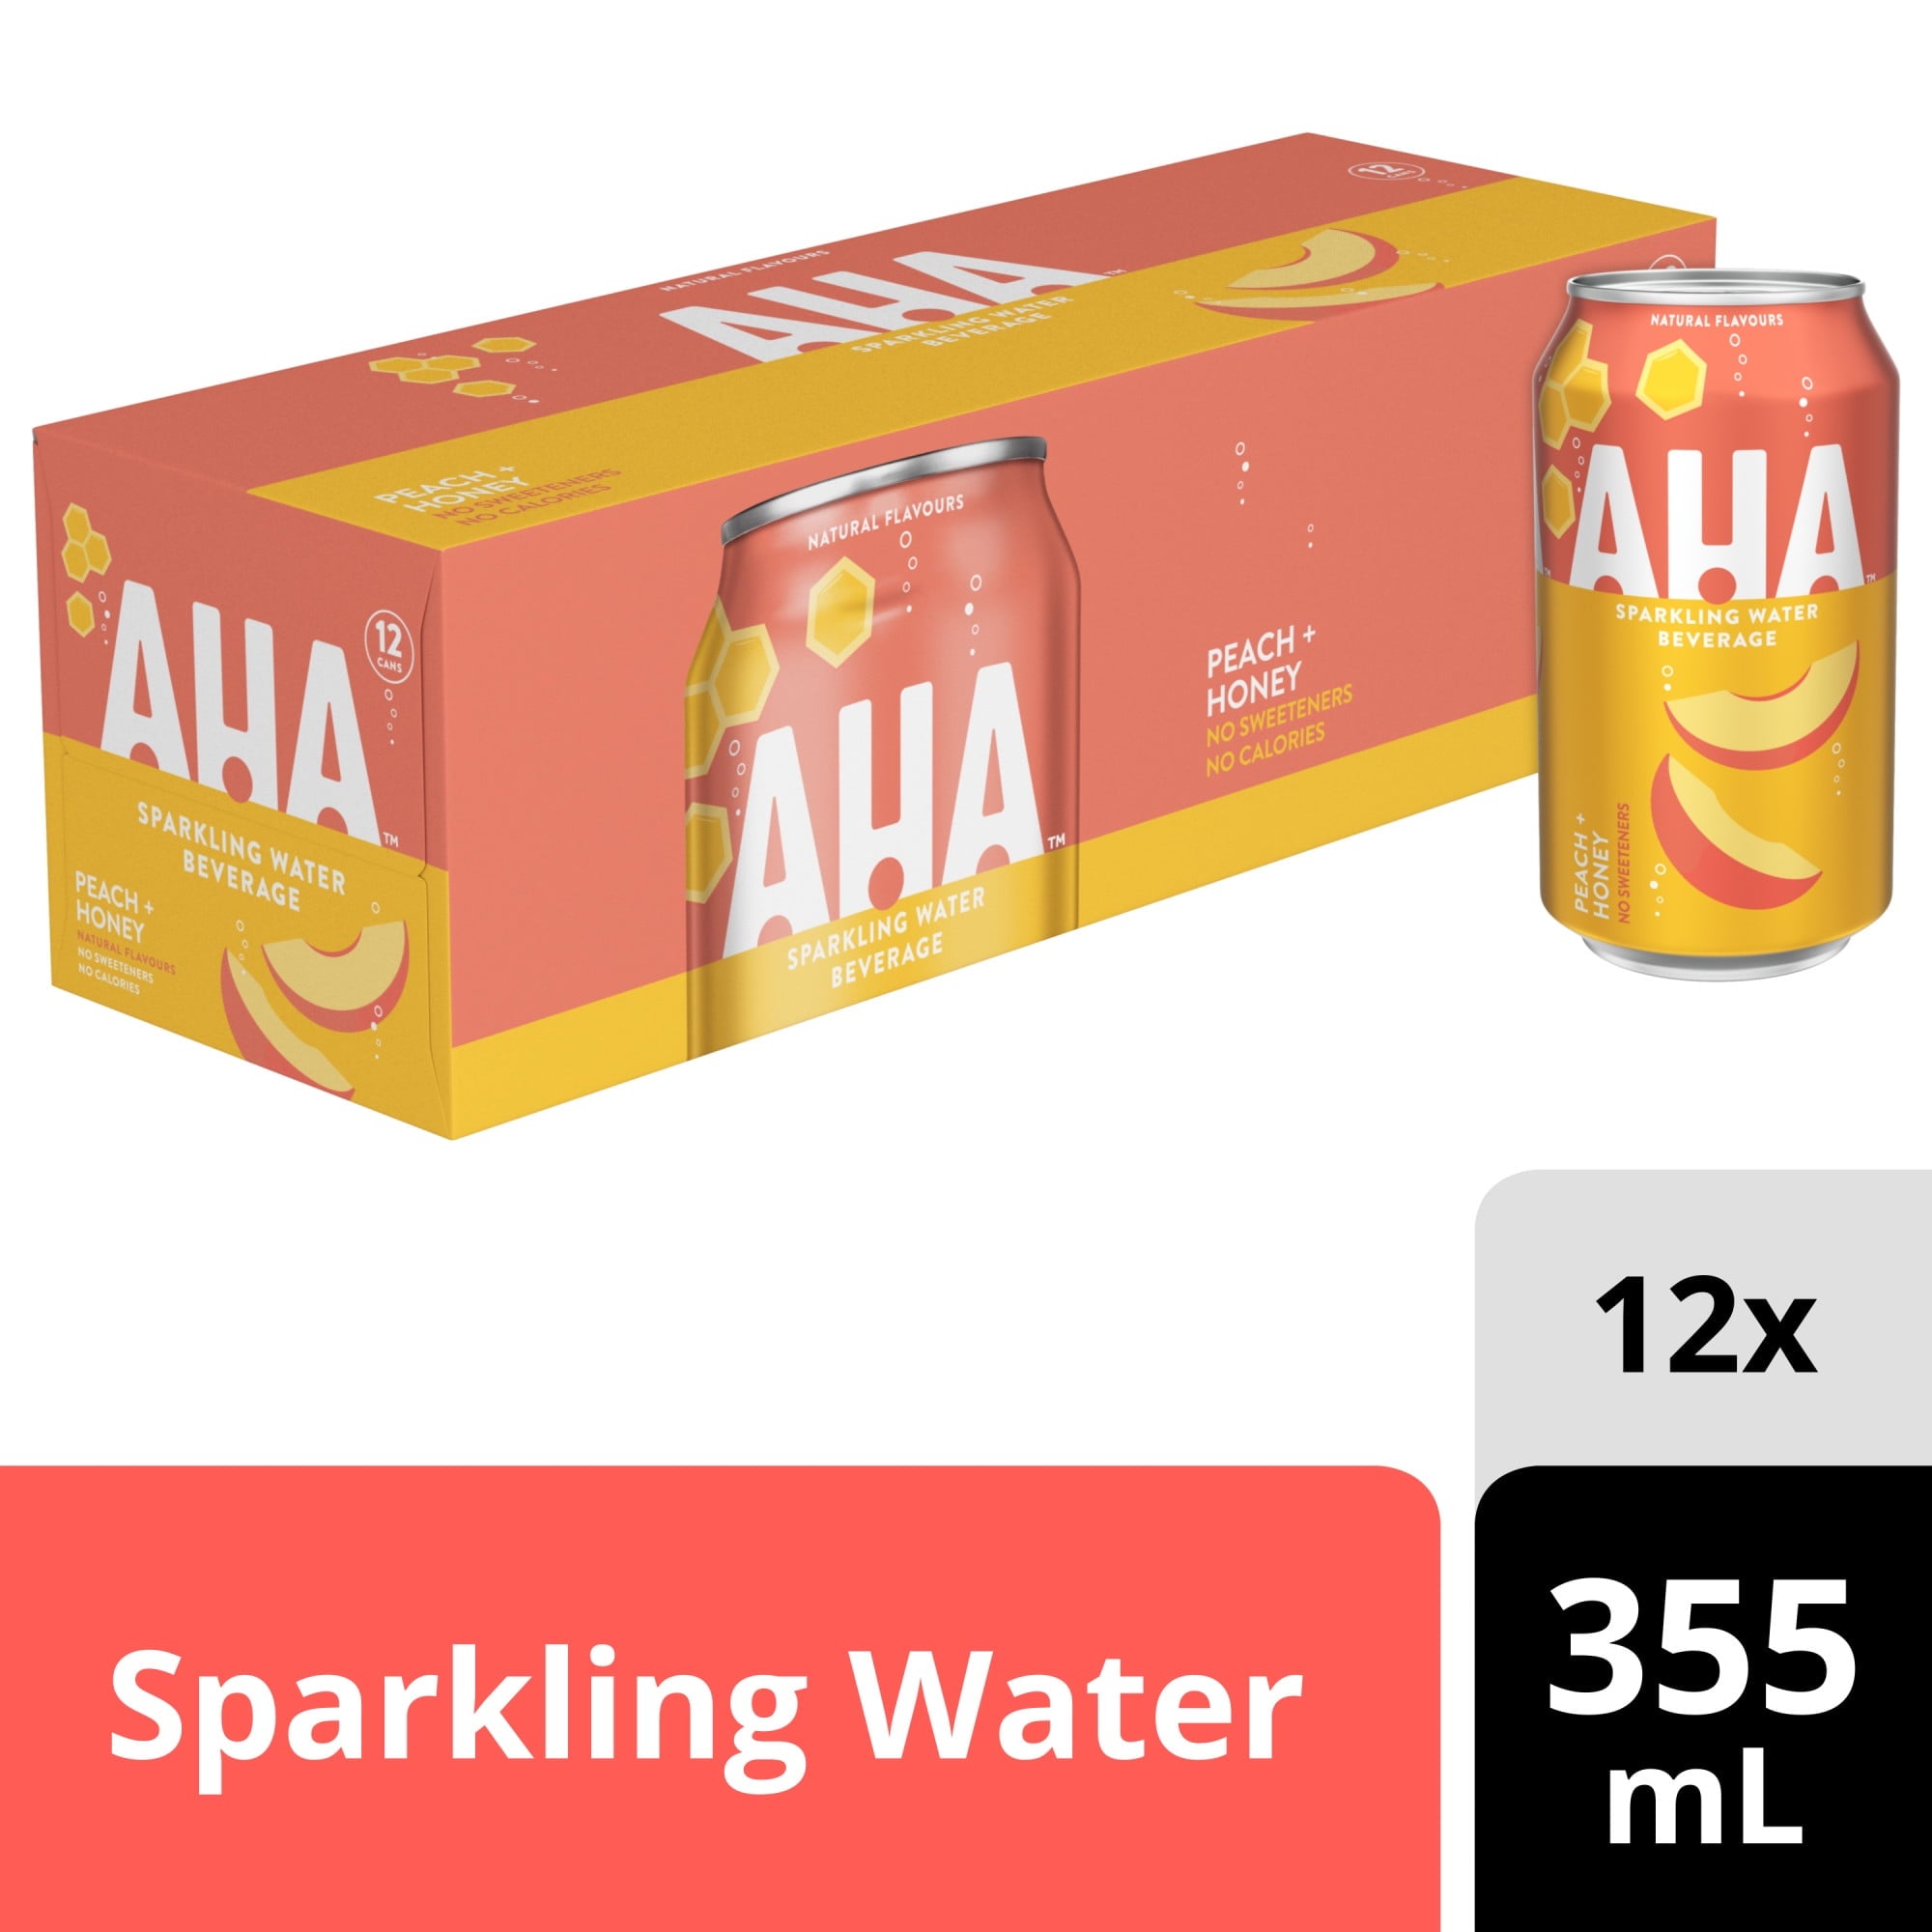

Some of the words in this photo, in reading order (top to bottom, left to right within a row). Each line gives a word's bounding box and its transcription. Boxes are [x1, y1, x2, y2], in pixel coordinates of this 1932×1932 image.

[1358, 163, 1406, 175] 12
[659, 271, 742, 292] NATURAL
[740, 249, 831, 273] FLAVOURS
[659, 251, 1106, 362] AHA
[851, 315, 990, 353] SPARKLING
[989, 295, 1075, 318] WATER
[921, 311, 1052, 347] BEVERAGE
[1650, 313, 1711, 327] NATURAL
[1715, 313, 1784, 327] FLAVOURS
[373, 469, 497, 504] PEACH
[402, 476, 530, 512] HONEY
[432, 505, 475, 520] NO
[473, 469, 622, 509] SWEETENERS
[455, 512, 498, 526] NO
[497, 483, 611, 515] CALORIES
[808, 512, 879, 552] NATURAL
[884, 494, 965, 526] FLAVOURS
[1569, 443, 1865, 599] AHA
[375, 619, 403, 659] 12
[1615, 603, 1740, 625] SPARKLING
[1747, 603, 1819, 623] WATER
[1658, 630, 1777, 648] BEVERAGE
[377, 657, 403, 673] CANS
[1208, 625, 1294, 678] PEACH
[100, 580, 382, 847] AHA
[1208, 661, 1302, 717] HONEY
[1207, 721, 1236, 748] NO
[1239, 683, 1353, 737] SWEETENERS
[1207, 752, 1235, 778] NO
[1238, 722, 1325, 766] CALORIES
[723, 662, 1045, 959] AHA
[137, 801, 262, 866] SPARKLING
[270, 846, 346, 895] WATER
[1574, 832, 1589, 913] PEACH
[1617, 803, 1631, 897] SWEETENERS
[75, 870, 139, 914] PEACH
[183, 849, 301, 913] BEVERAGE
[1592, 830, 1609, 920] HONEY
[76, 899, 145, 944] HONEY
[787, 910, 909, 971] SPARKLING
[915, 886, 985, 925] WATER
[1617, 900, 1631, 924] NO
[77, 929, 123, 955] NATURAL
[125, 947, 177, 976] FLAVOURS
[77, 947, 93, 960] NO
[95, 952, 155, 983] SWEETENERS
[831, 930, 945, 989] BEVERAGE
[78, 963, 93, 977] NO
[95, 969, 140, 995] CALORIES
